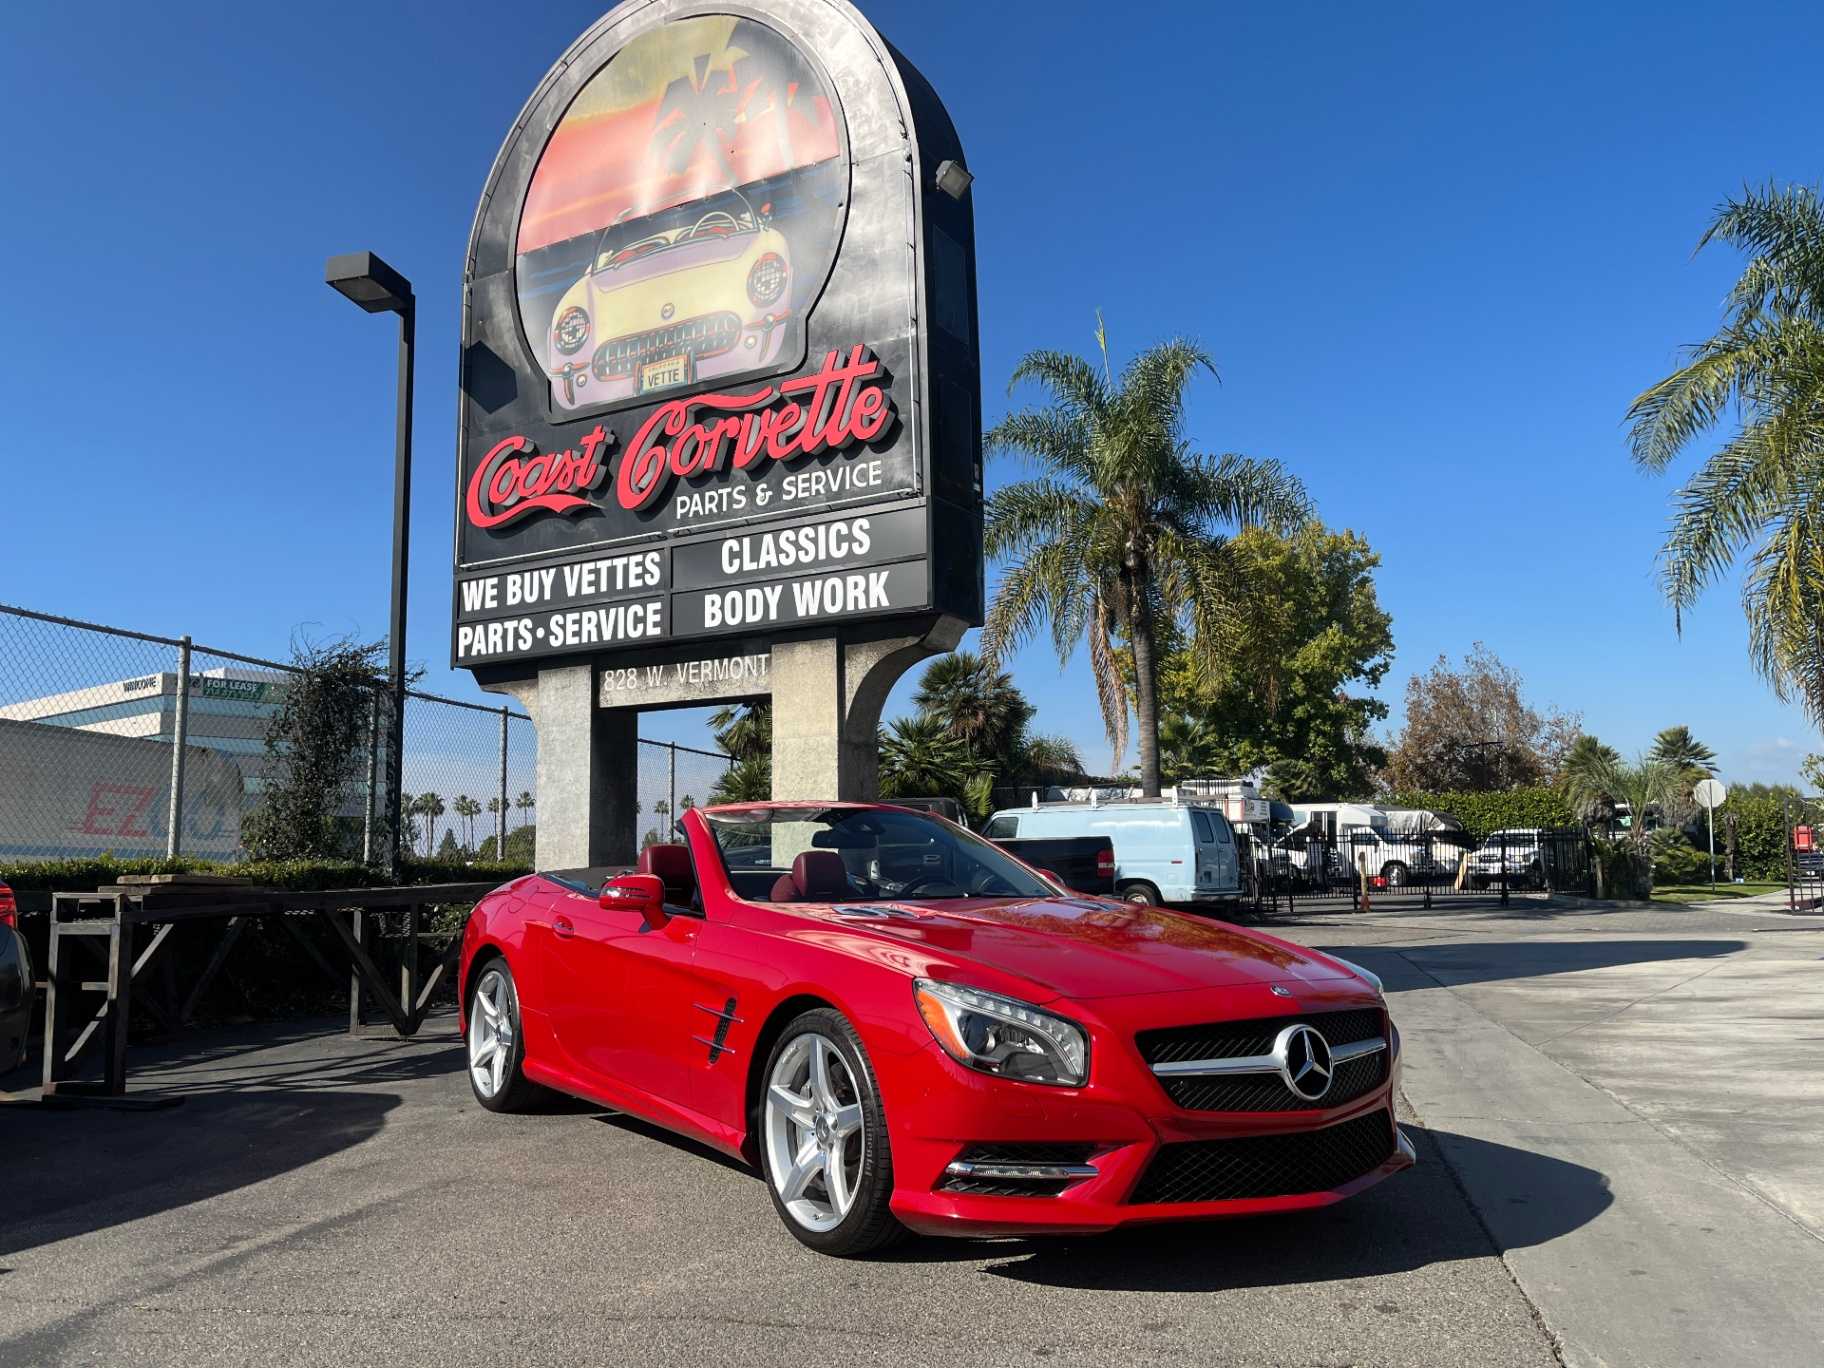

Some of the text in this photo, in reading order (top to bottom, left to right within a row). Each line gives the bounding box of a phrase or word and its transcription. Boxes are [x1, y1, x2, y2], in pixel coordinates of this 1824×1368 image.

[648, 368, 680, 387] VETTE
[466, 343, 891, 529] Coast Corvette
[676, 460, 882, 519] PARTS & SERVICE
[721, 518, 871, 575] CLASSICS
[462, 551, 661, 612] WE BUY VETTES
[704, 570, 890, 628] BODY WORK
[207, 679, 257, 693] FOR LEASE
[603, 653, 770, 691] 828 W. VERMONT
